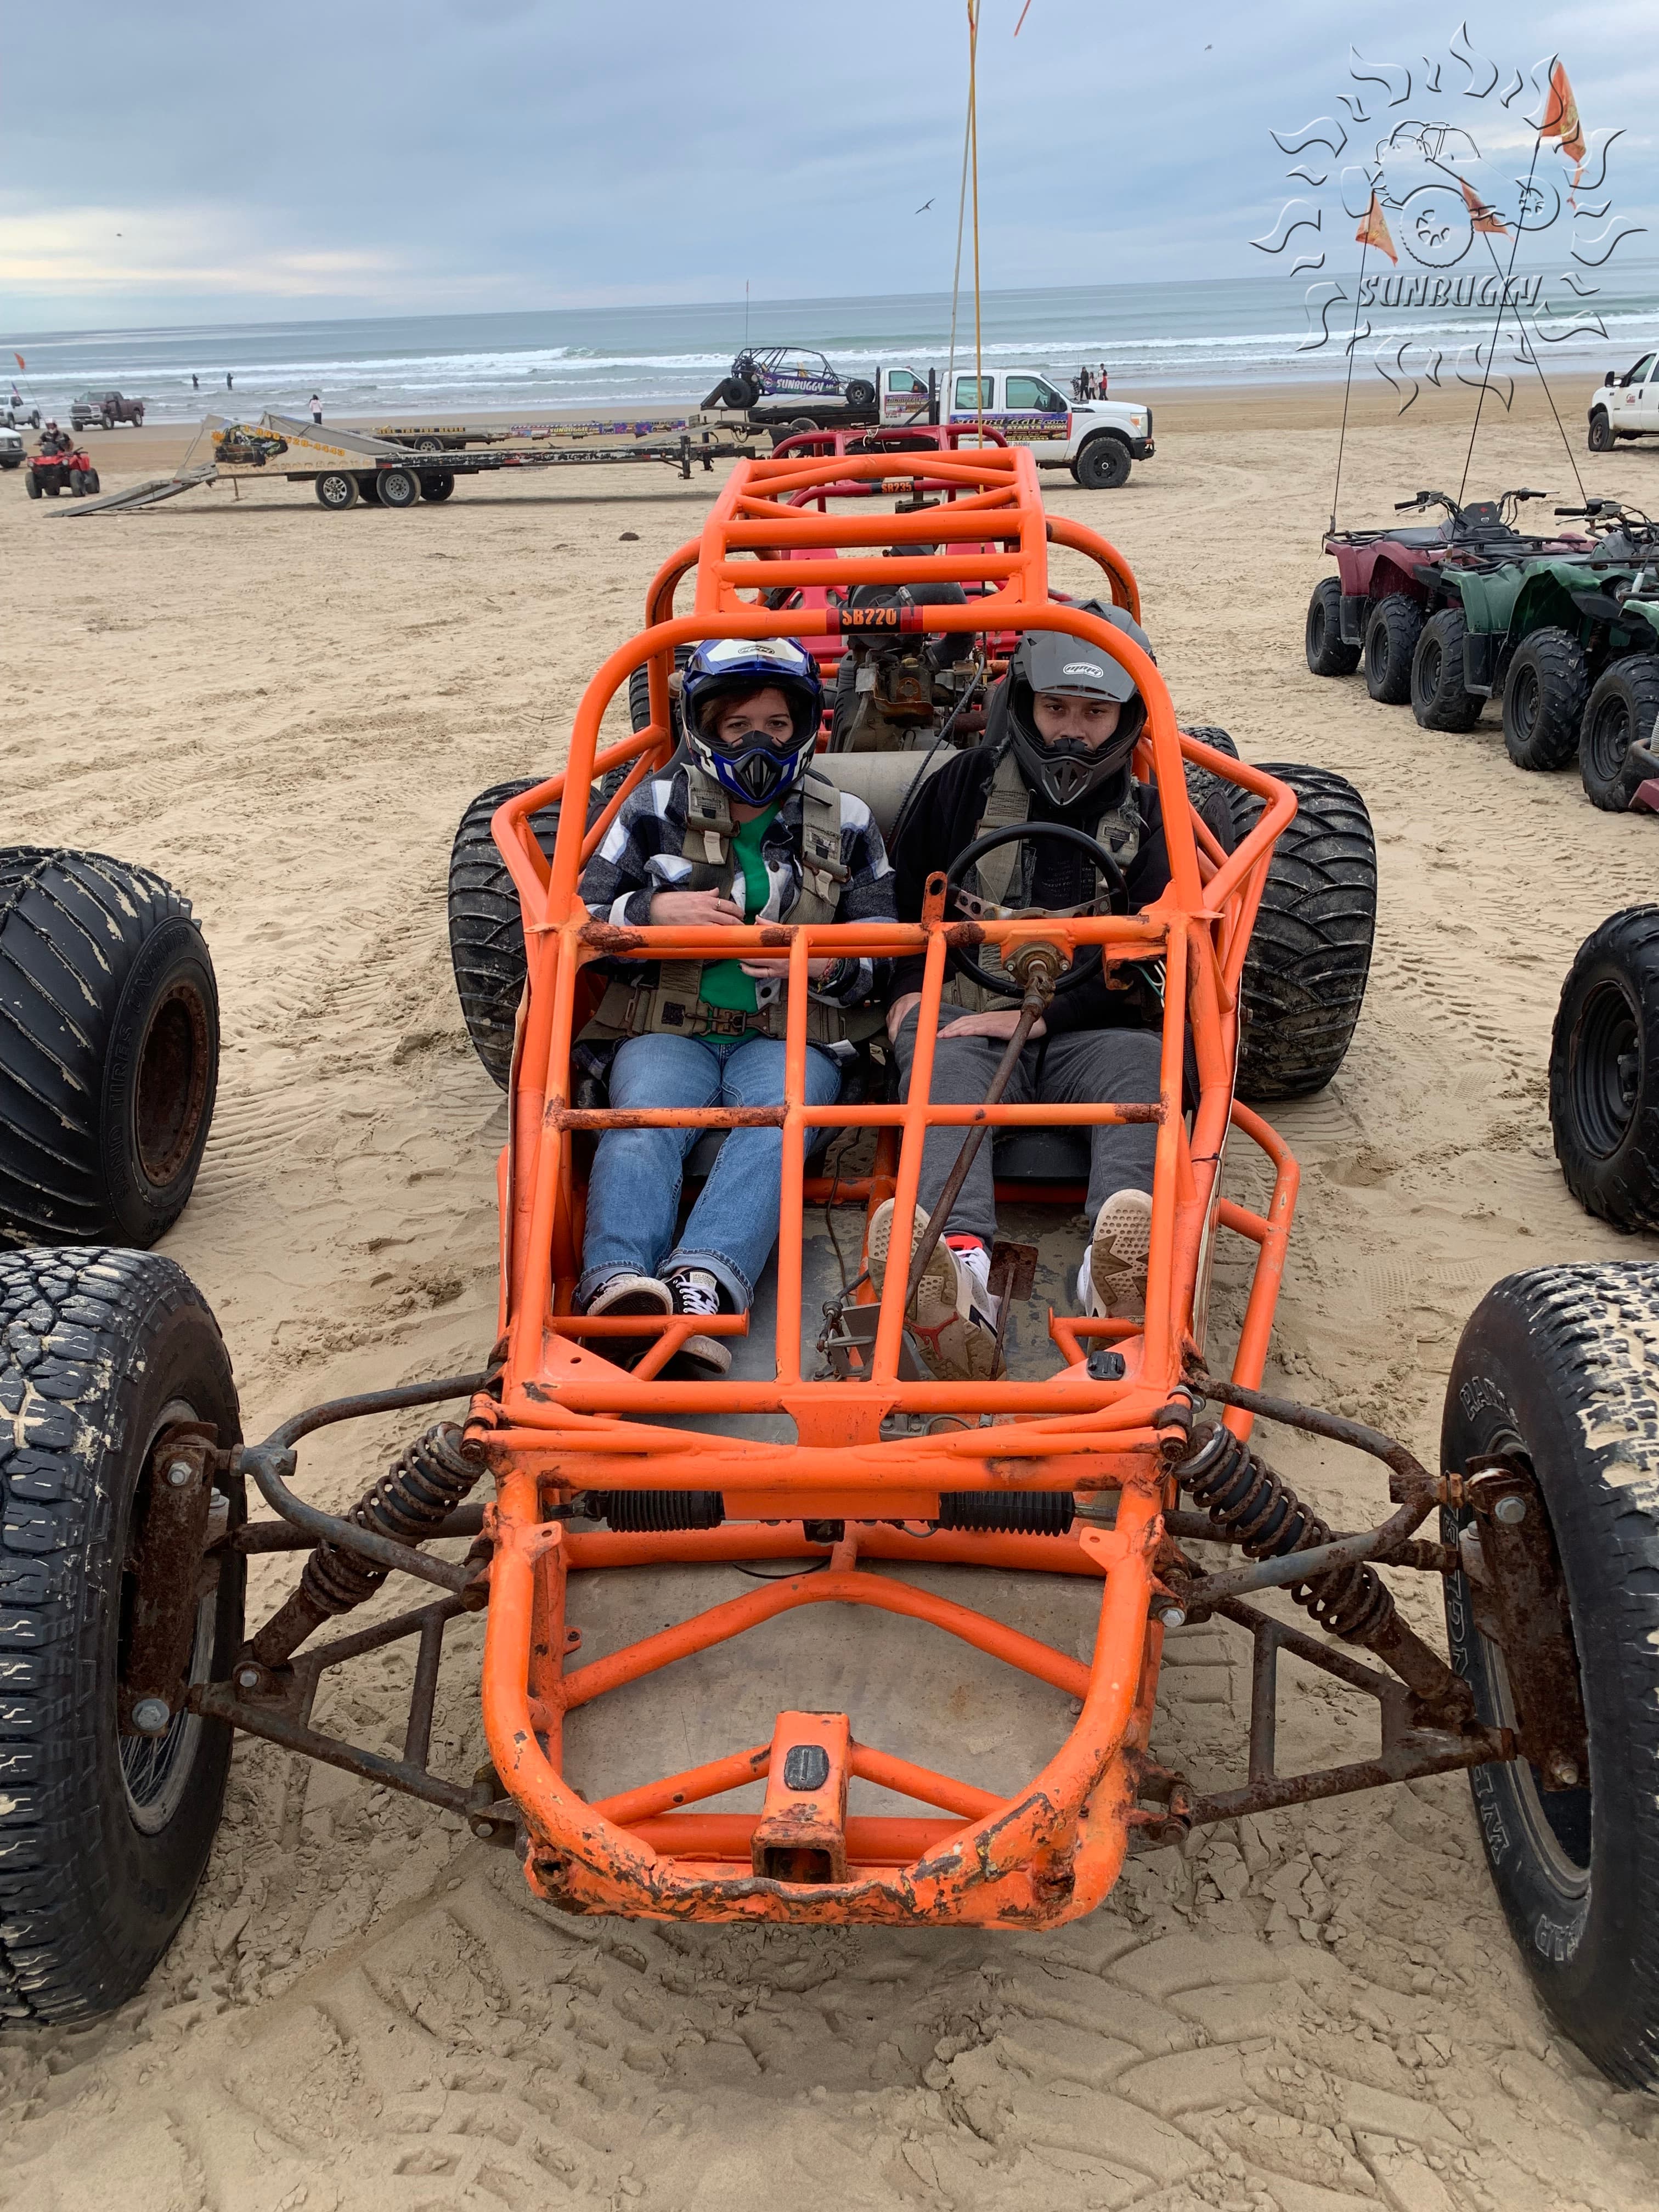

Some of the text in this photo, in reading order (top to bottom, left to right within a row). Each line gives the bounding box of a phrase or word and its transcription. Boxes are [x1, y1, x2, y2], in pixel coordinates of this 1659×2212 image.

[776, 379, 825, 391] SUNBUGGY
[881, 482, 912, 493] SB235
[842, 608, 896, 626] SB220
[107, 925, 190, 1200] SAND TIRES UNLIMITED
